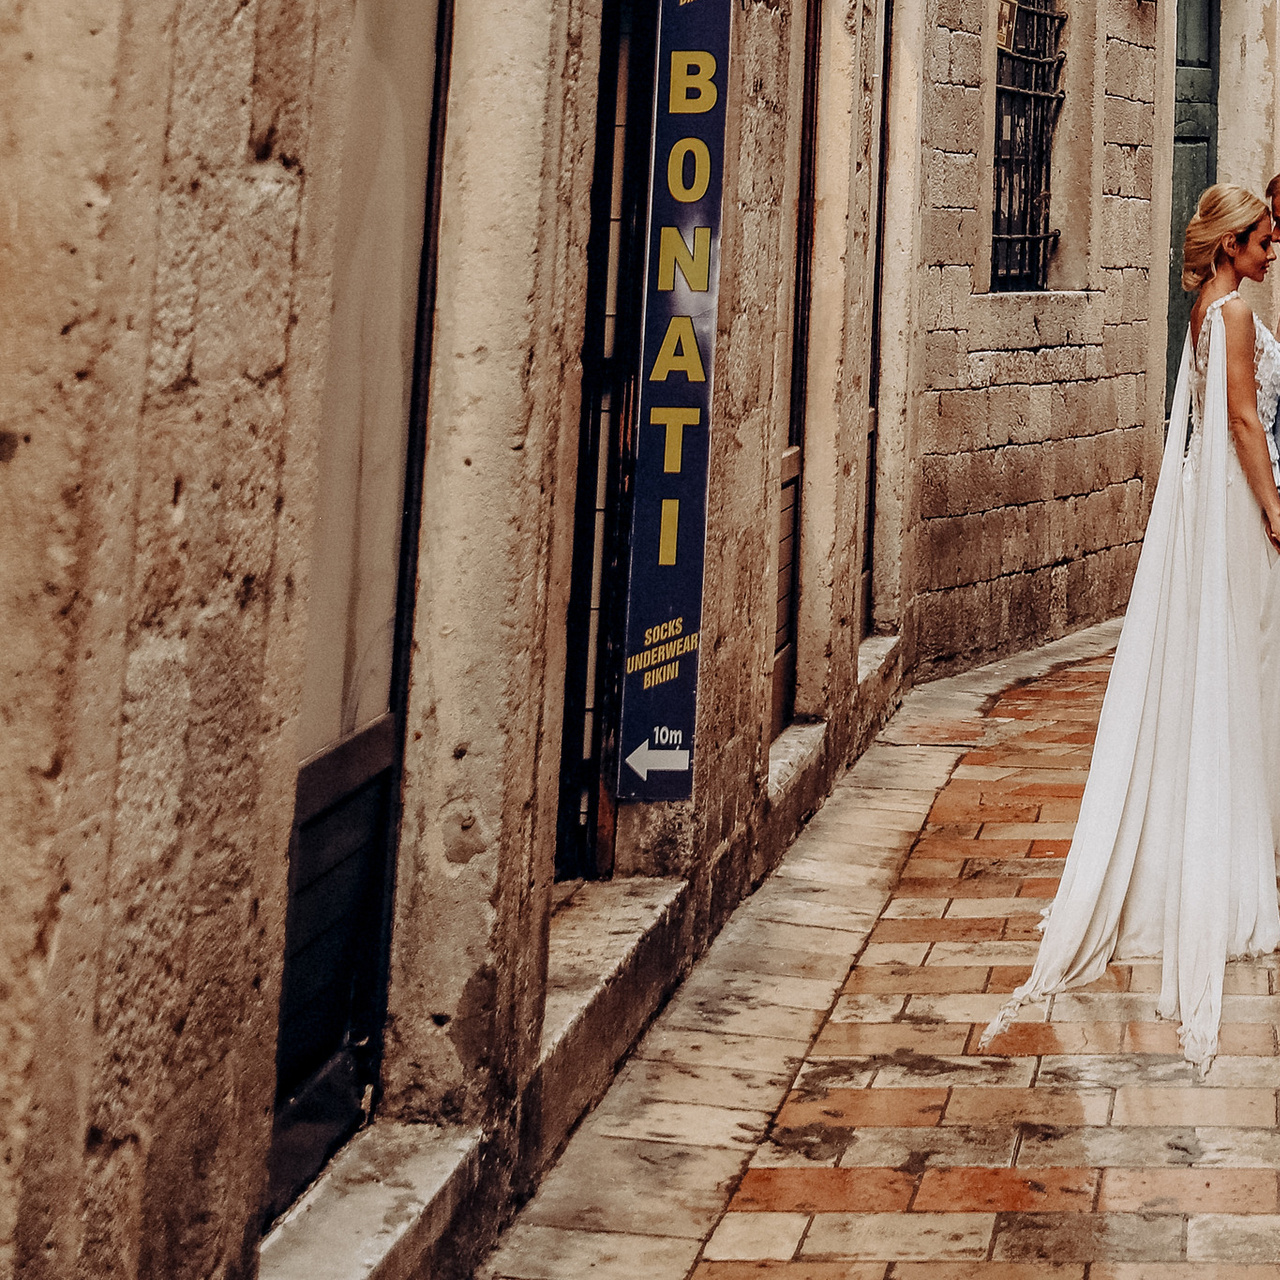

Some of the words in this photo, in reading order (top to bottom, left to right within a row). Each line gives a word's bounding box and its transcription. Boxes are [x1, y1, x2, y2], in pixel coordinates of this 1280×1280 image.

[648, 50, 718, 566] BONATI
[644, 616, 683, 647] SOCKS
[626, 632, 699, 674] UNDERWEAR
[643, 660, 680, 690] BIKINI
[653, 725, 683, 745] 10m
